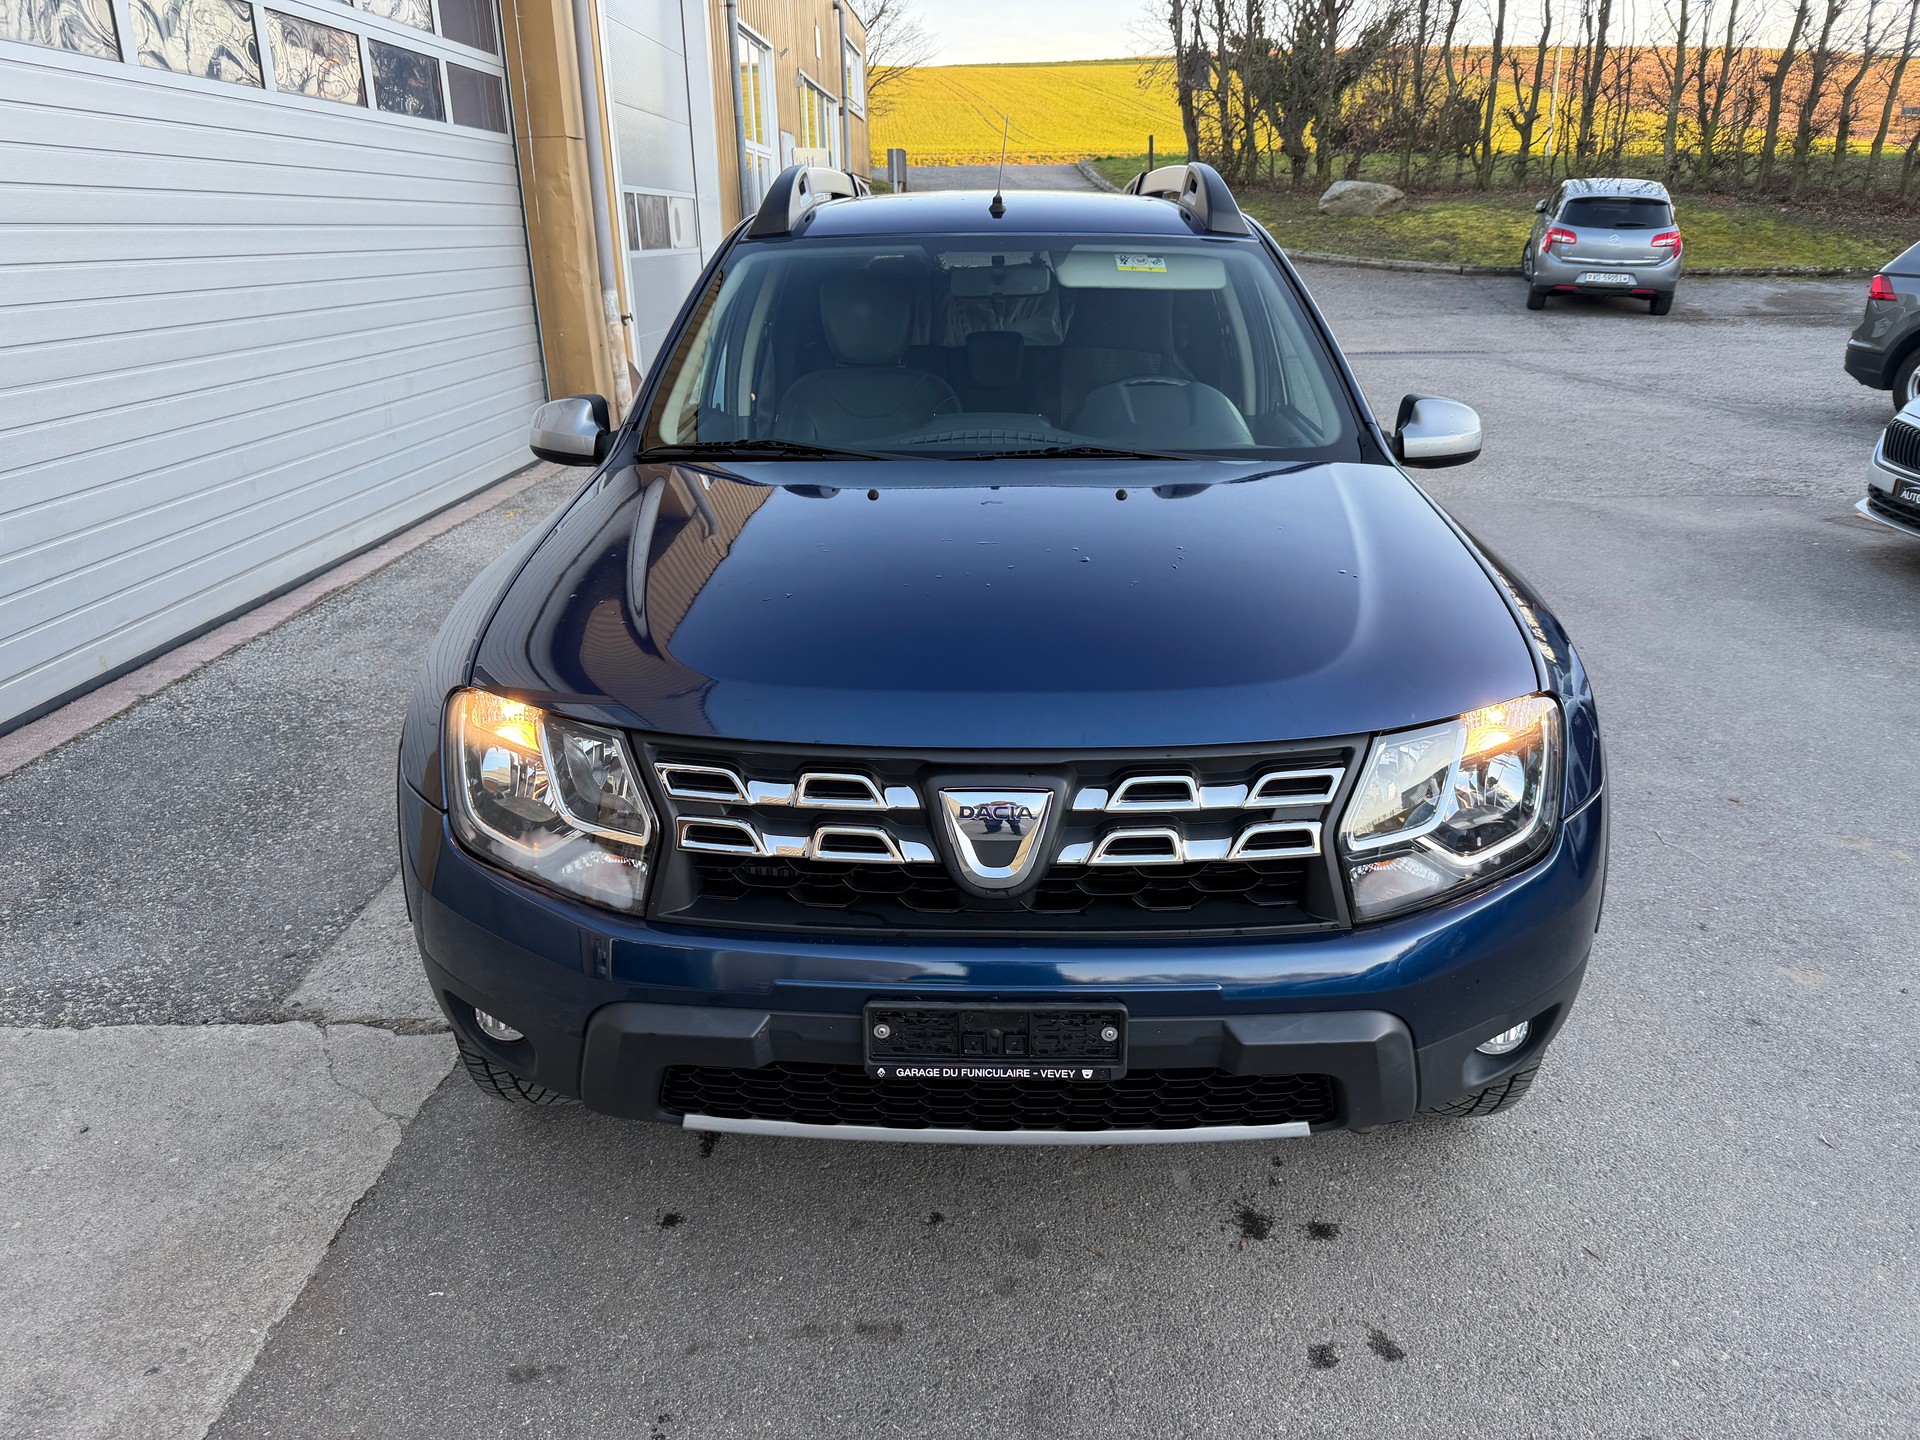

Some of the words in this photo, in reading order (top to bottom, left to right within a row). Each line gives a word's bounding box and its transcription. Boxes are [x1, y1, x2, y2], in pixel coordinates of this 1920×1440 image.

[959, 806, 1034, 820] DACIA
[896, 1068, 940, 1077] GARAGE
[942, 1068, 958, 1077] DU
[961, 1068, 1031, 1078] FUNICULAIRE
[1040, 1069, 1076, 1078] VEVEY
